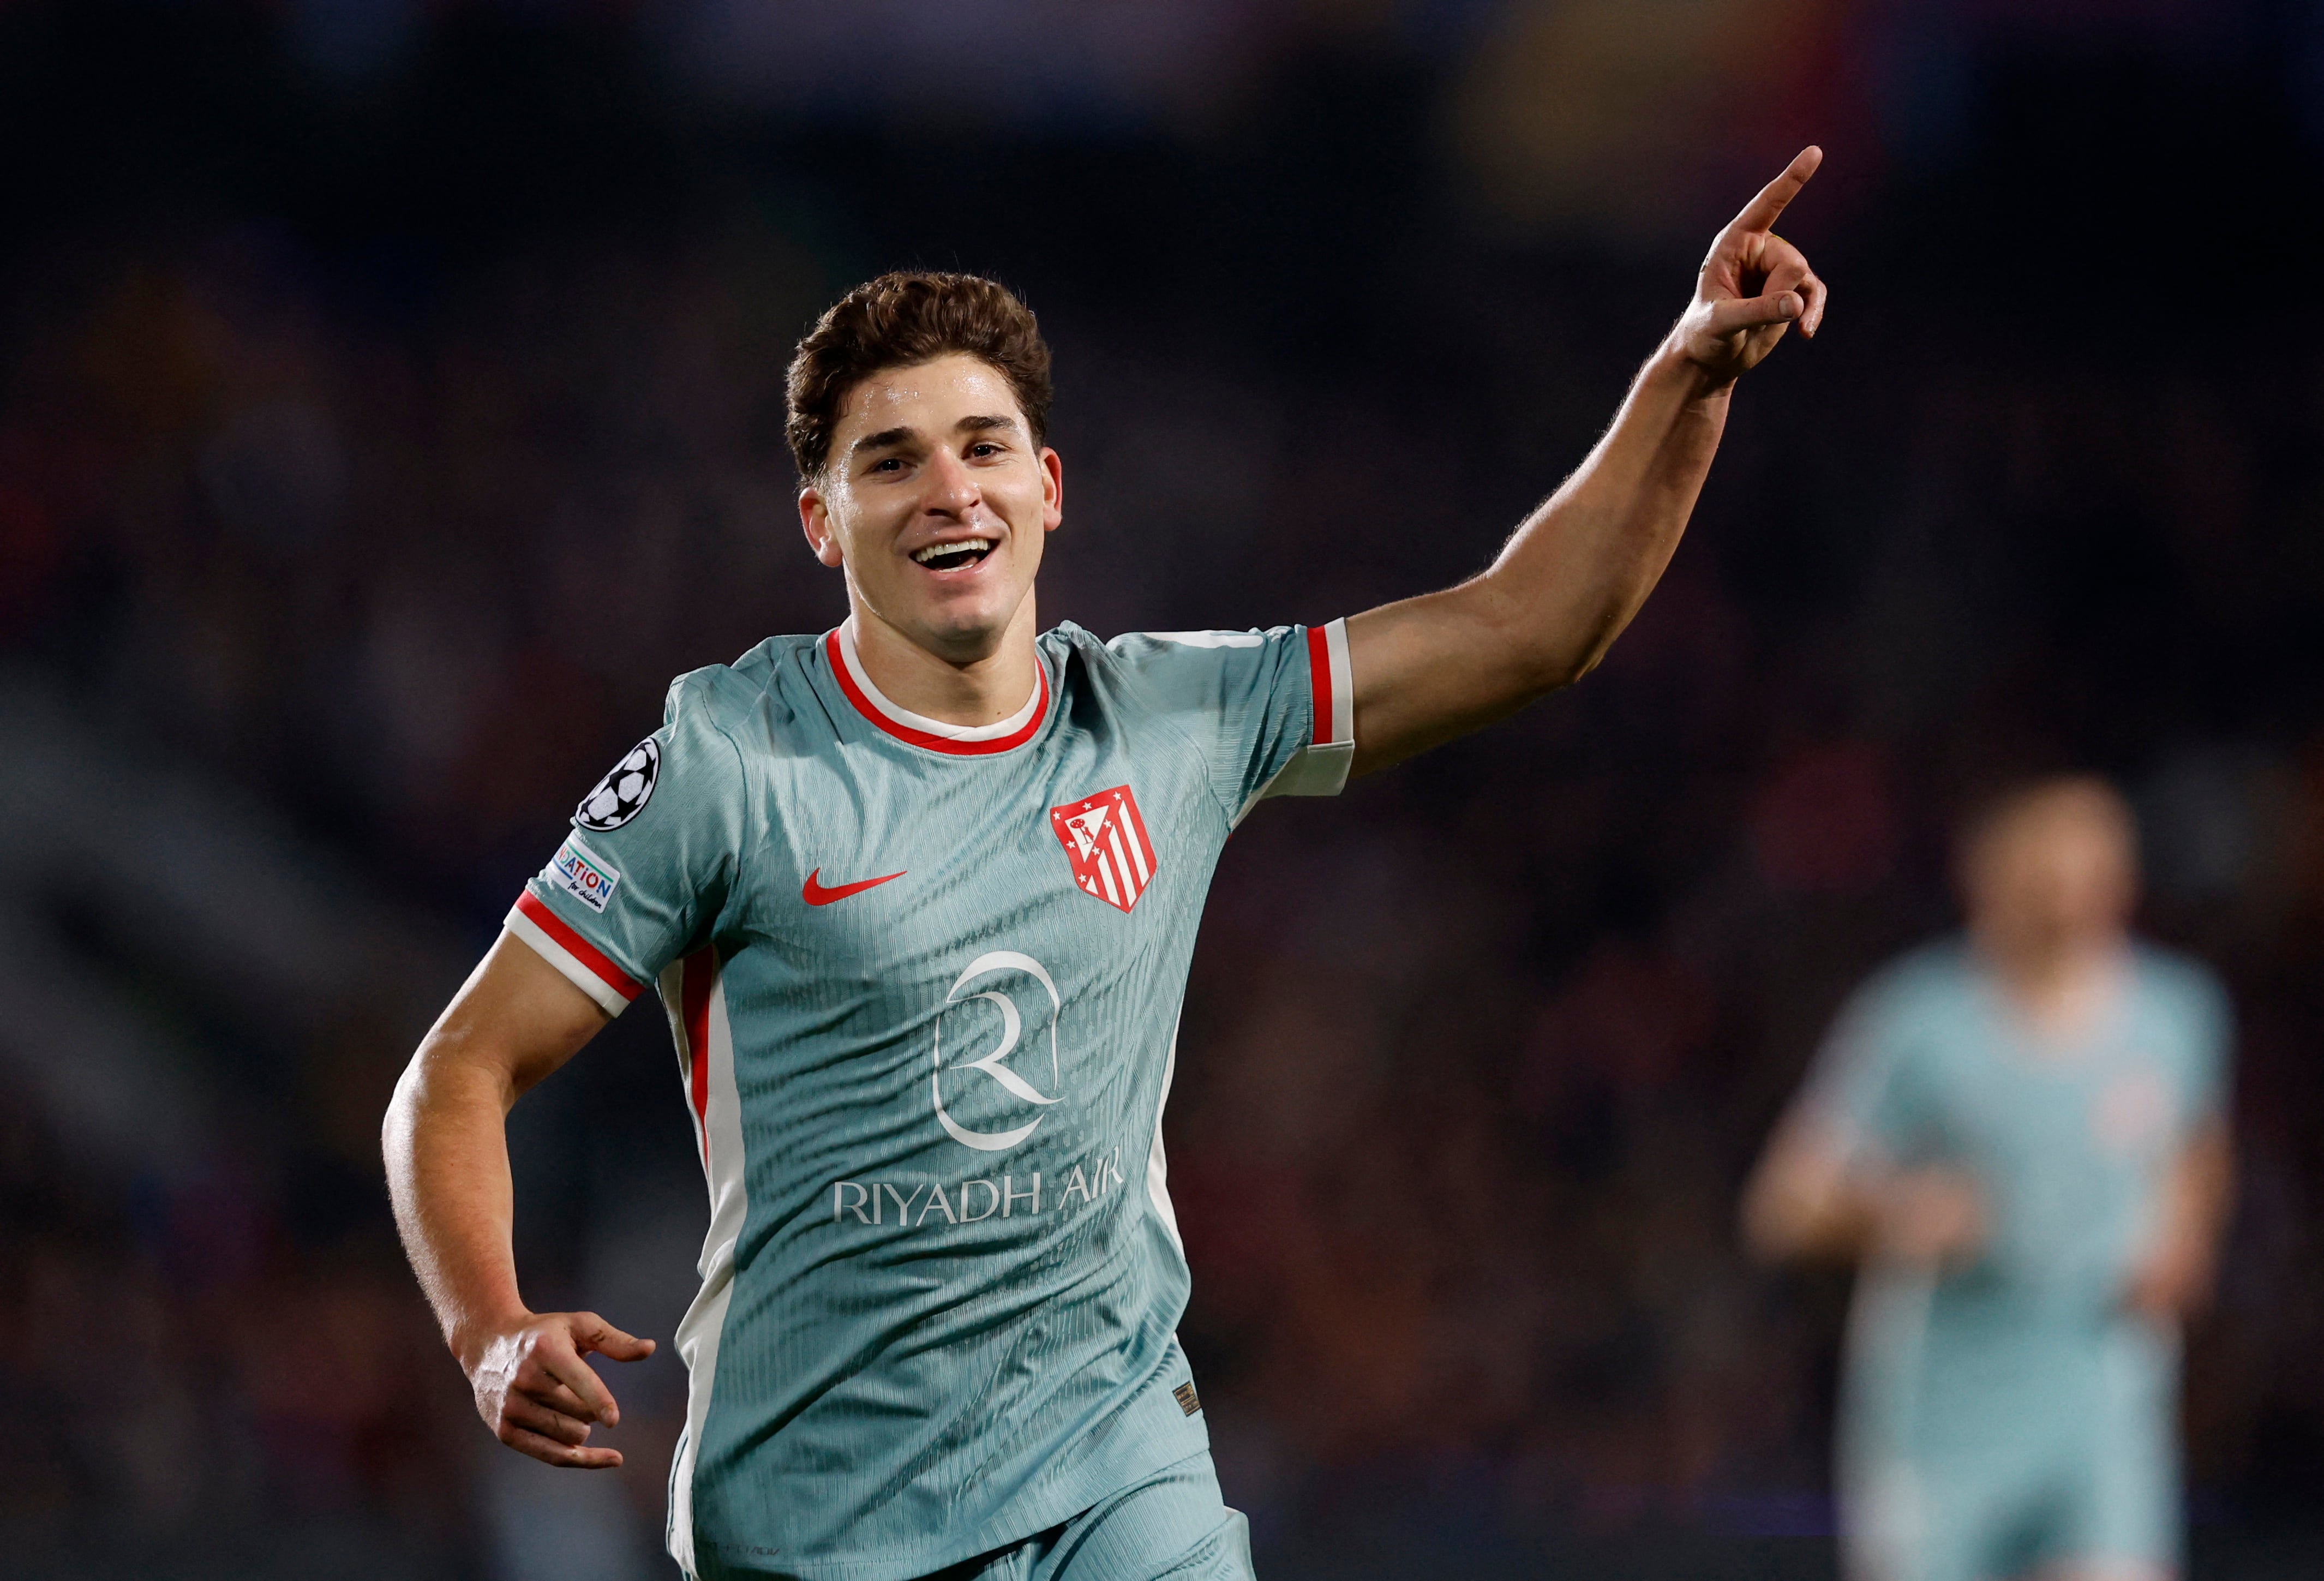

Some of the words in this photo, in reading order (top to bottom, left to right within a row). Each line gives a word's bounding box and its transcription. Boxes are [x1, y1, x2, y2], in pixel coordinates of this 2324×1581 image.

[567, 881, 579, 890] for
[578, 890, 602, 909] children
[834, 1172, 1040, 1227] RIYADH
[1058, 1146, 1123, 1210] AIR
